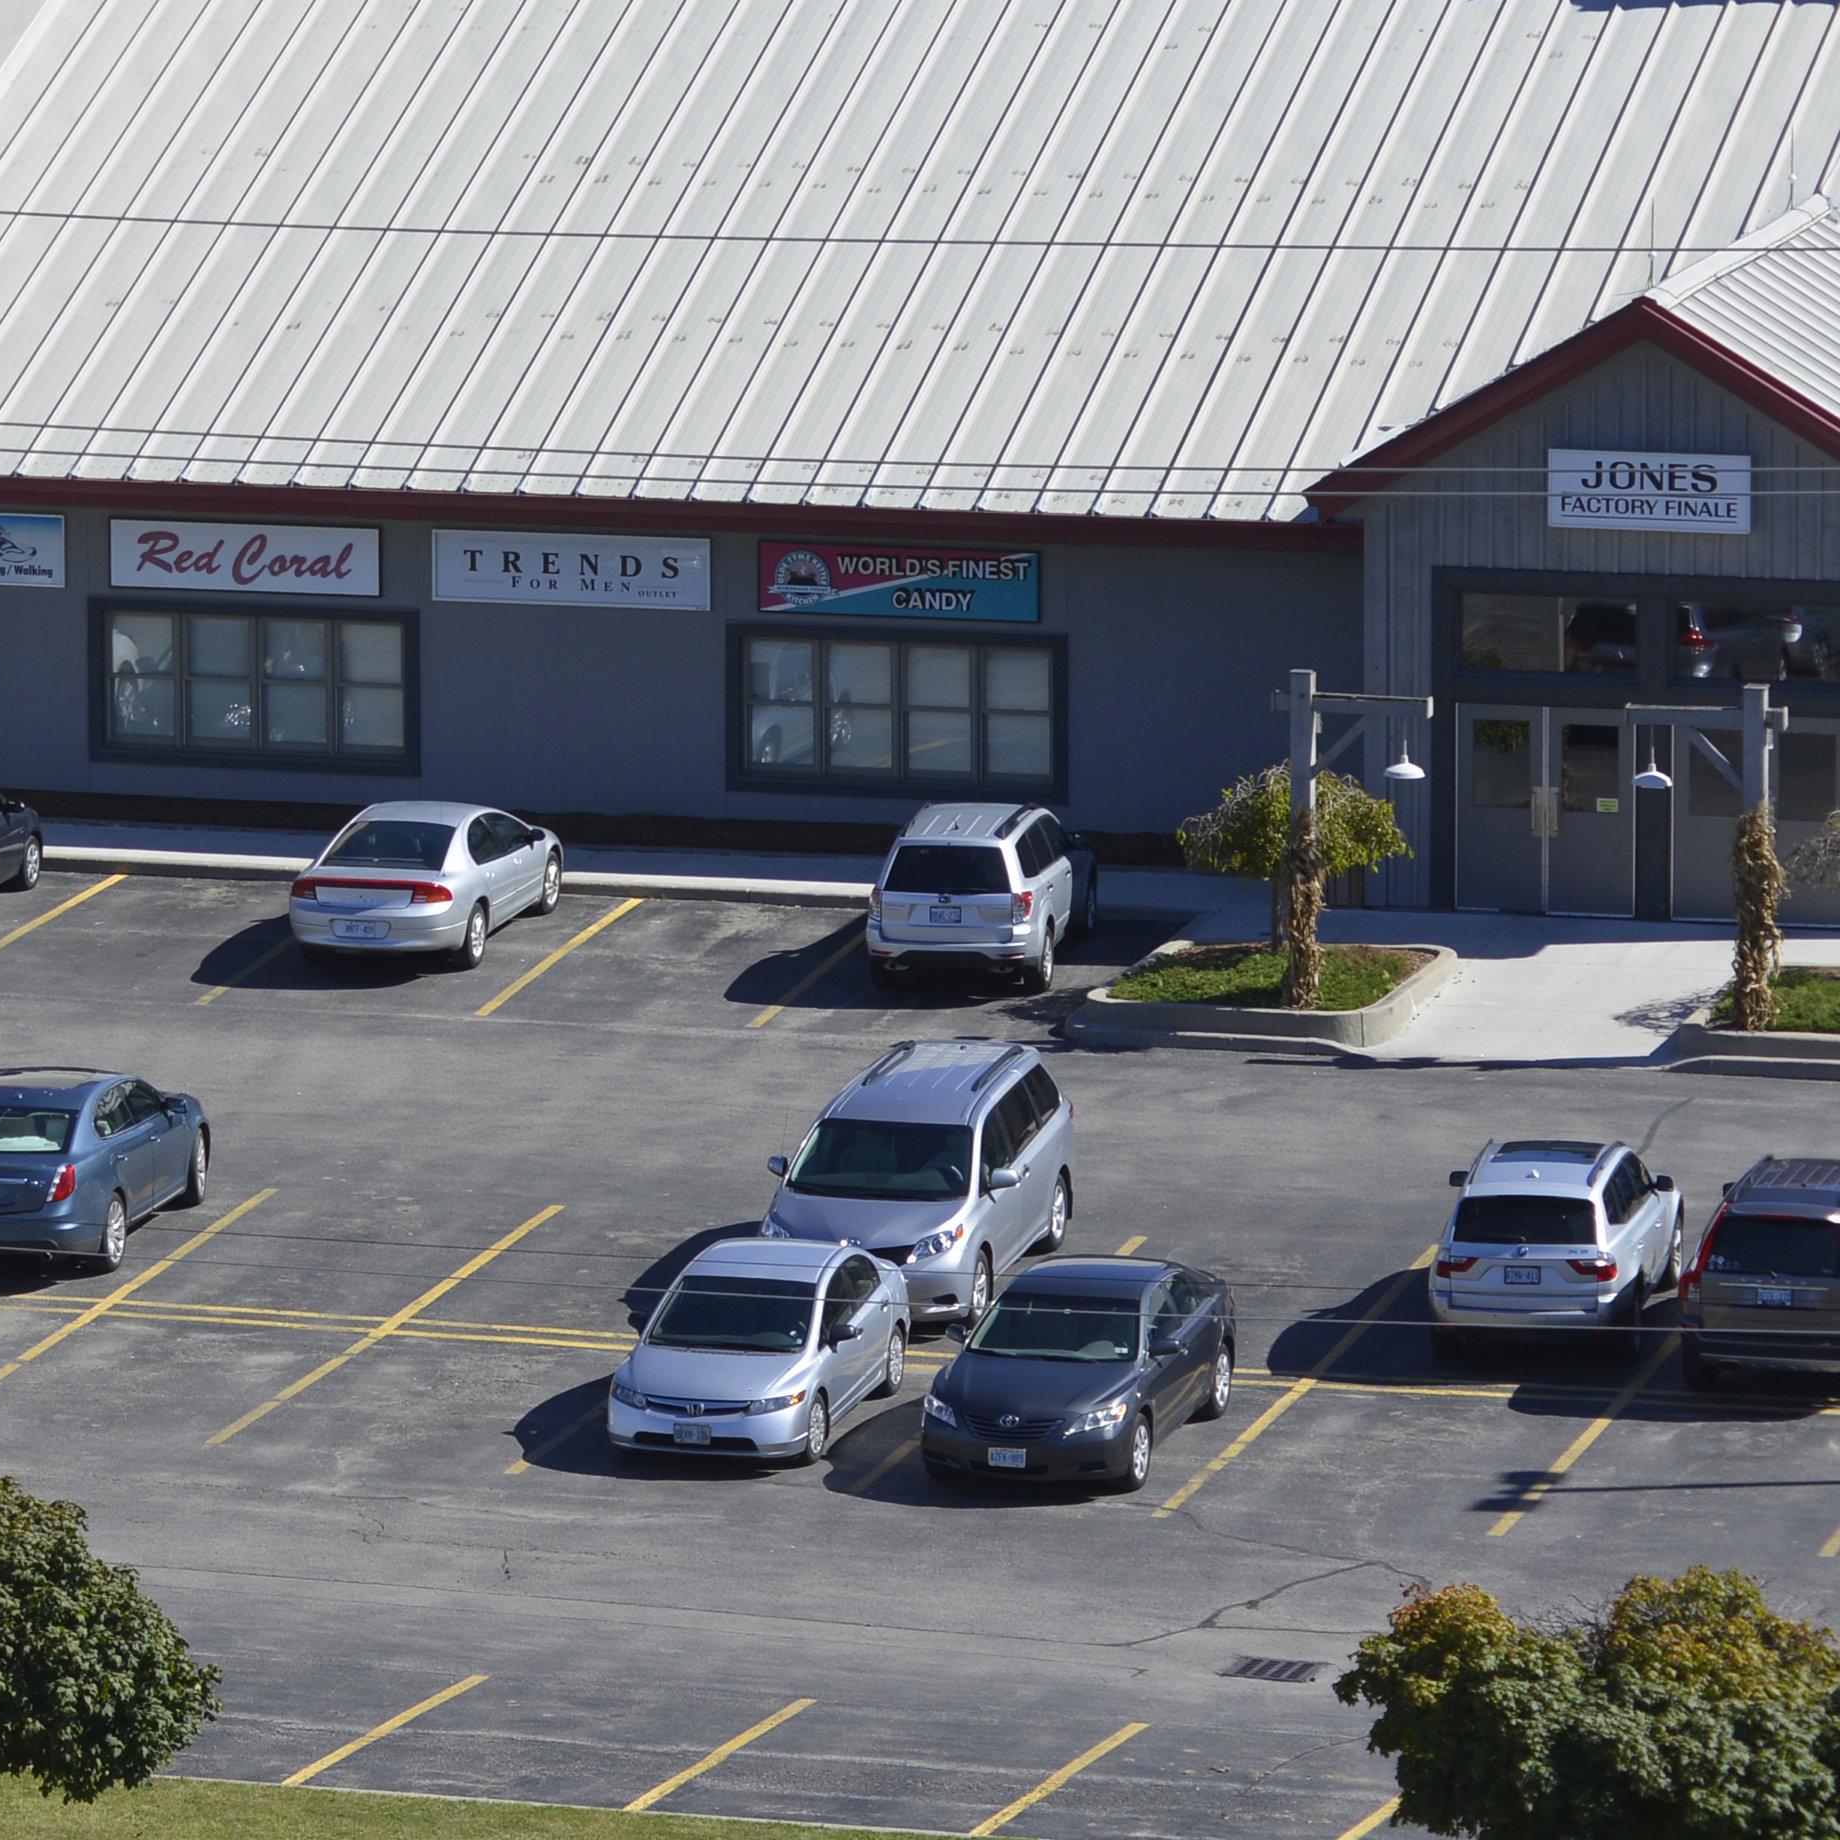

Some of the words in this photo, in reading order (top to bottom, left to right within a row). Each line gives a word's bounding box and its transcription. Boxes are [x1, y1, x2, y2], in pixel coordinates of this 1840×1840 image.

[1581, 461, 1717, 493] JONES
[1561, 495, 1658, 515] FACTORY
[1665, 499, 1738, 519] FINALE
[137, 530, 224, 574] Red
[232, 533, 354, 586] Coral
[463, 549, 679, 579] TRENDS
[837, 556, 940, 578] WORLD'S
[947, 559, 1029, 581] FINEST
[14, 564, 53, 578] Walking
[638, 590, 677, 598] OUTLET
[893, 591, 972, 611] CANDY
